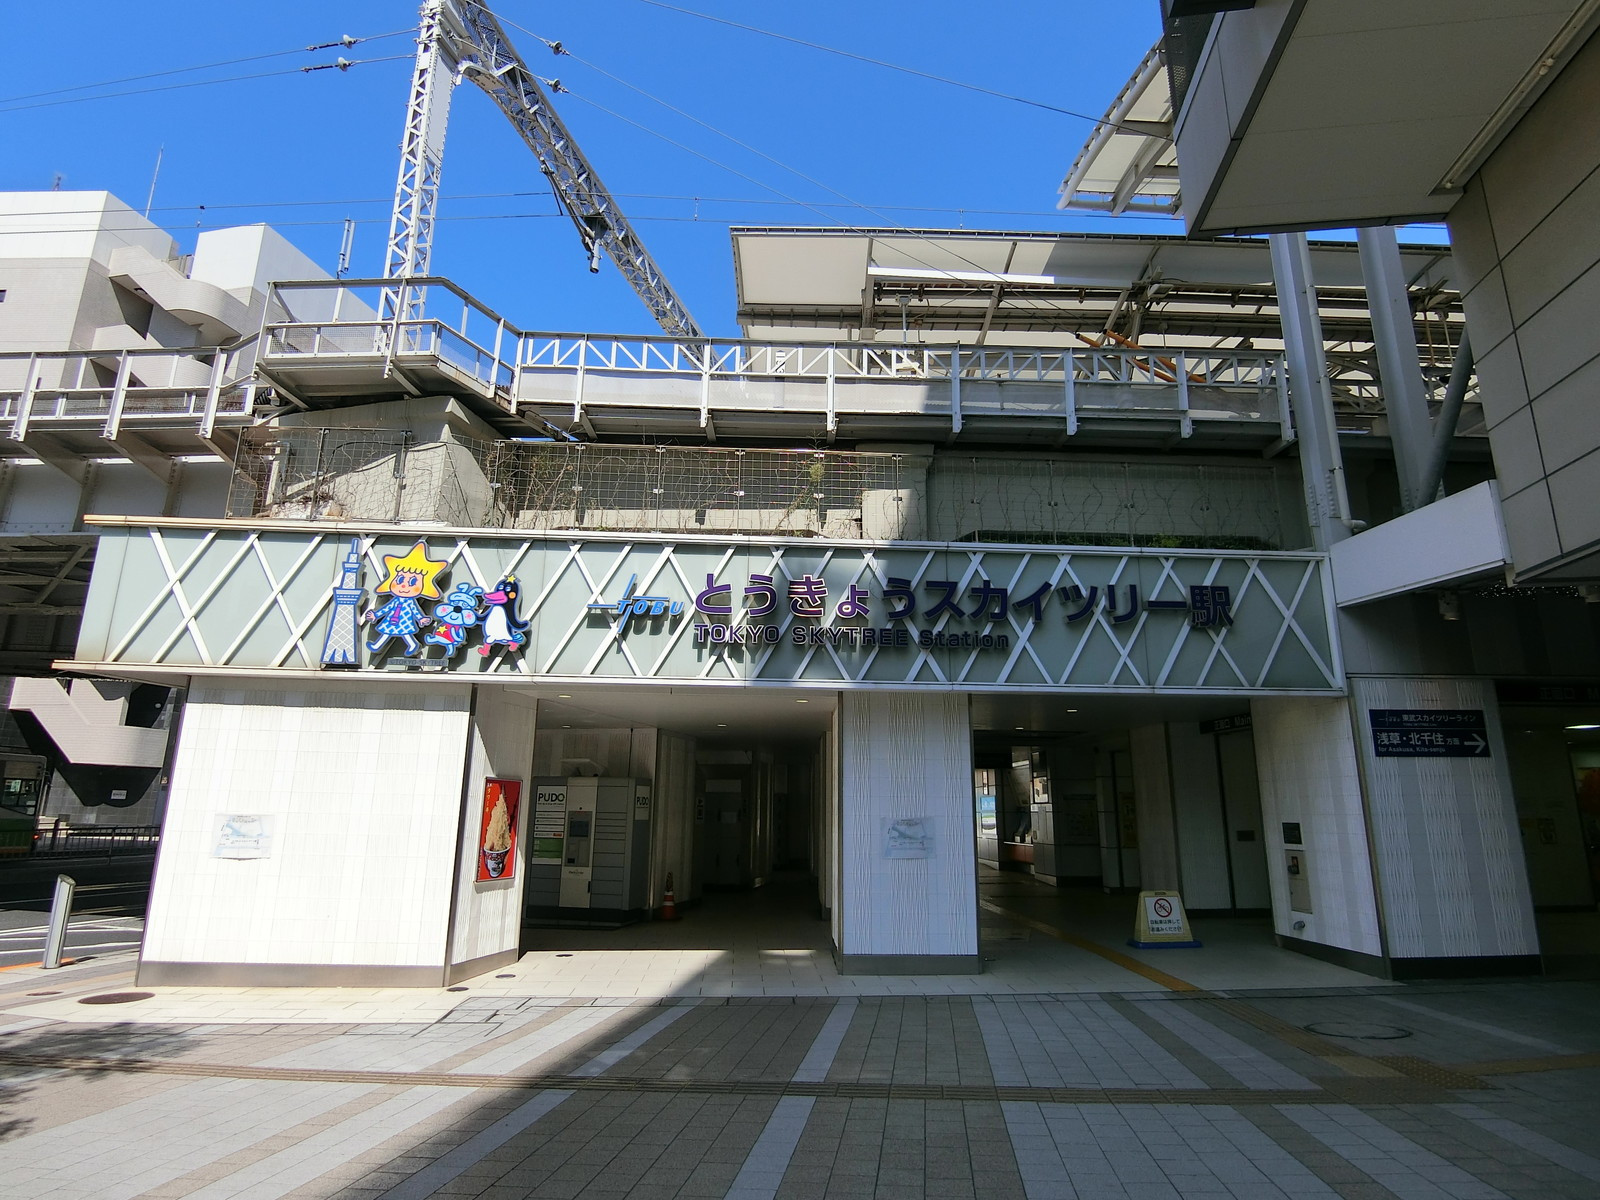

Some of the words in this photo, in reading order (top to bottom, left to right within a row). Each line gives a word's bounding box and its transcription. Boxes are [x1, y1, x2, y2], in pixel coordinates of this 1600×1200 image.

[694, 573, 1234, 628] とうきょうスカイツリー駅
[694, 623, 780, 644] TOKYO
[792, 624, 908, 648] SKYTREE
[918, 629, 1010, 649] Station
[538, 793, 565, 802] PUDO
